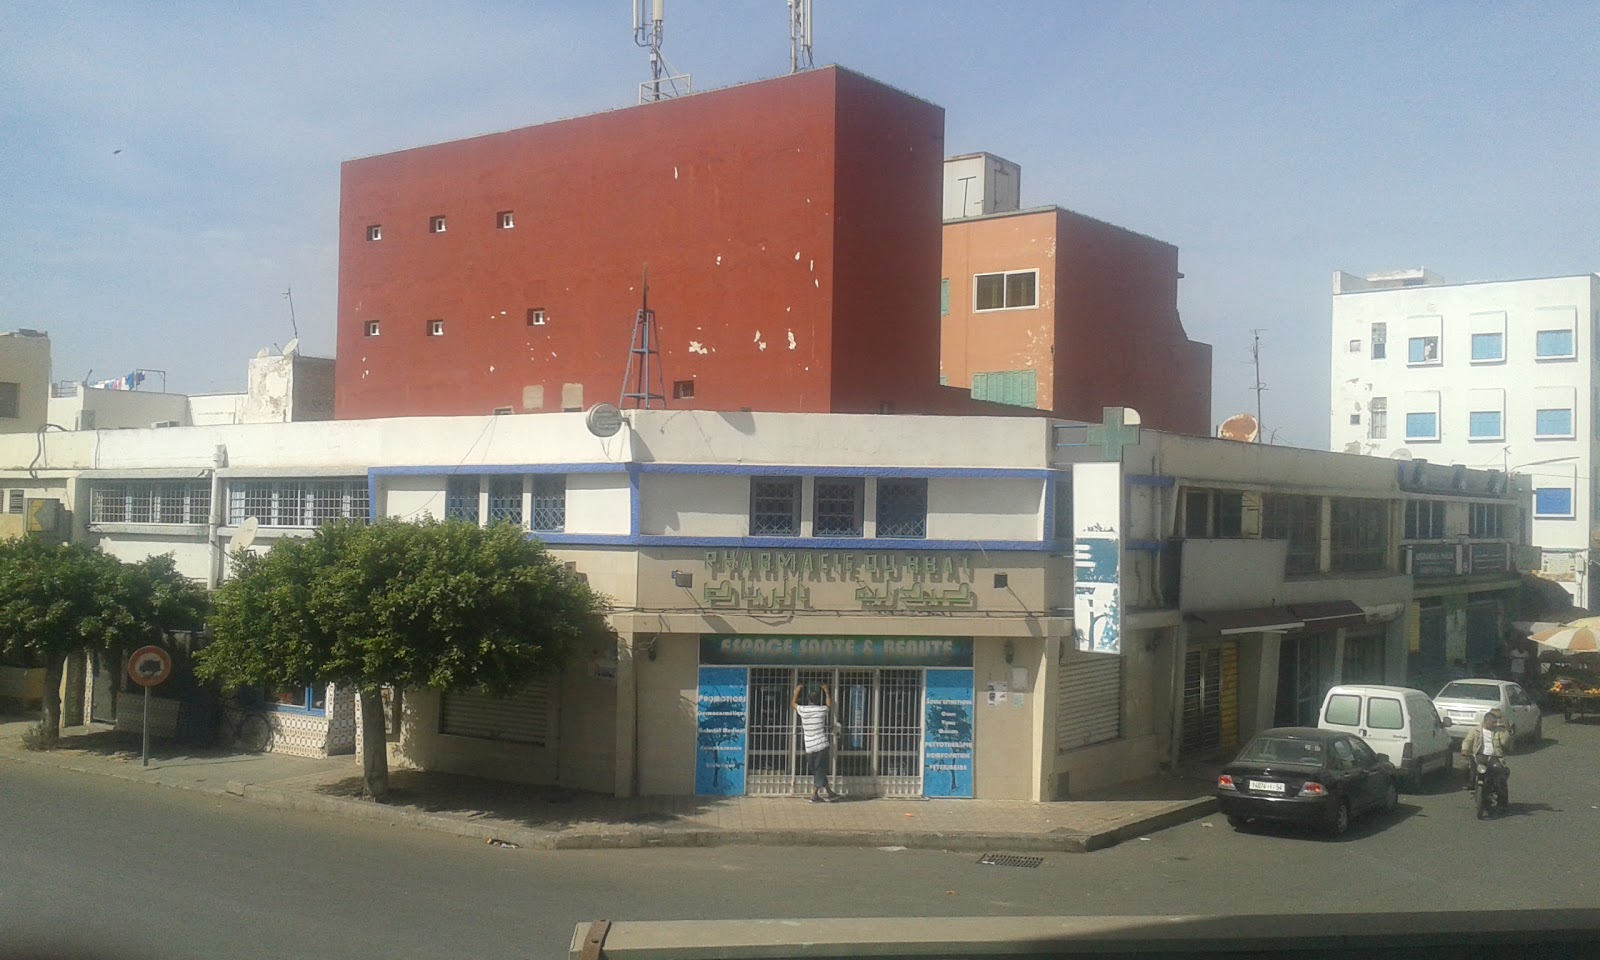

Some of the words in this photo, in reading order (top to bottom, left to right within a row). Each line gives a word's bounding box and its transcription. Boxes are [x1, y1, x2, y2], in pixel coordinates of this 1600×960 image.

[704, 550, 854, 573] PHARMACIE
[864, 554, 895, 573] DU
[720, 638, 793, 656] ESPACE
[862, 639, 873, 657] &
